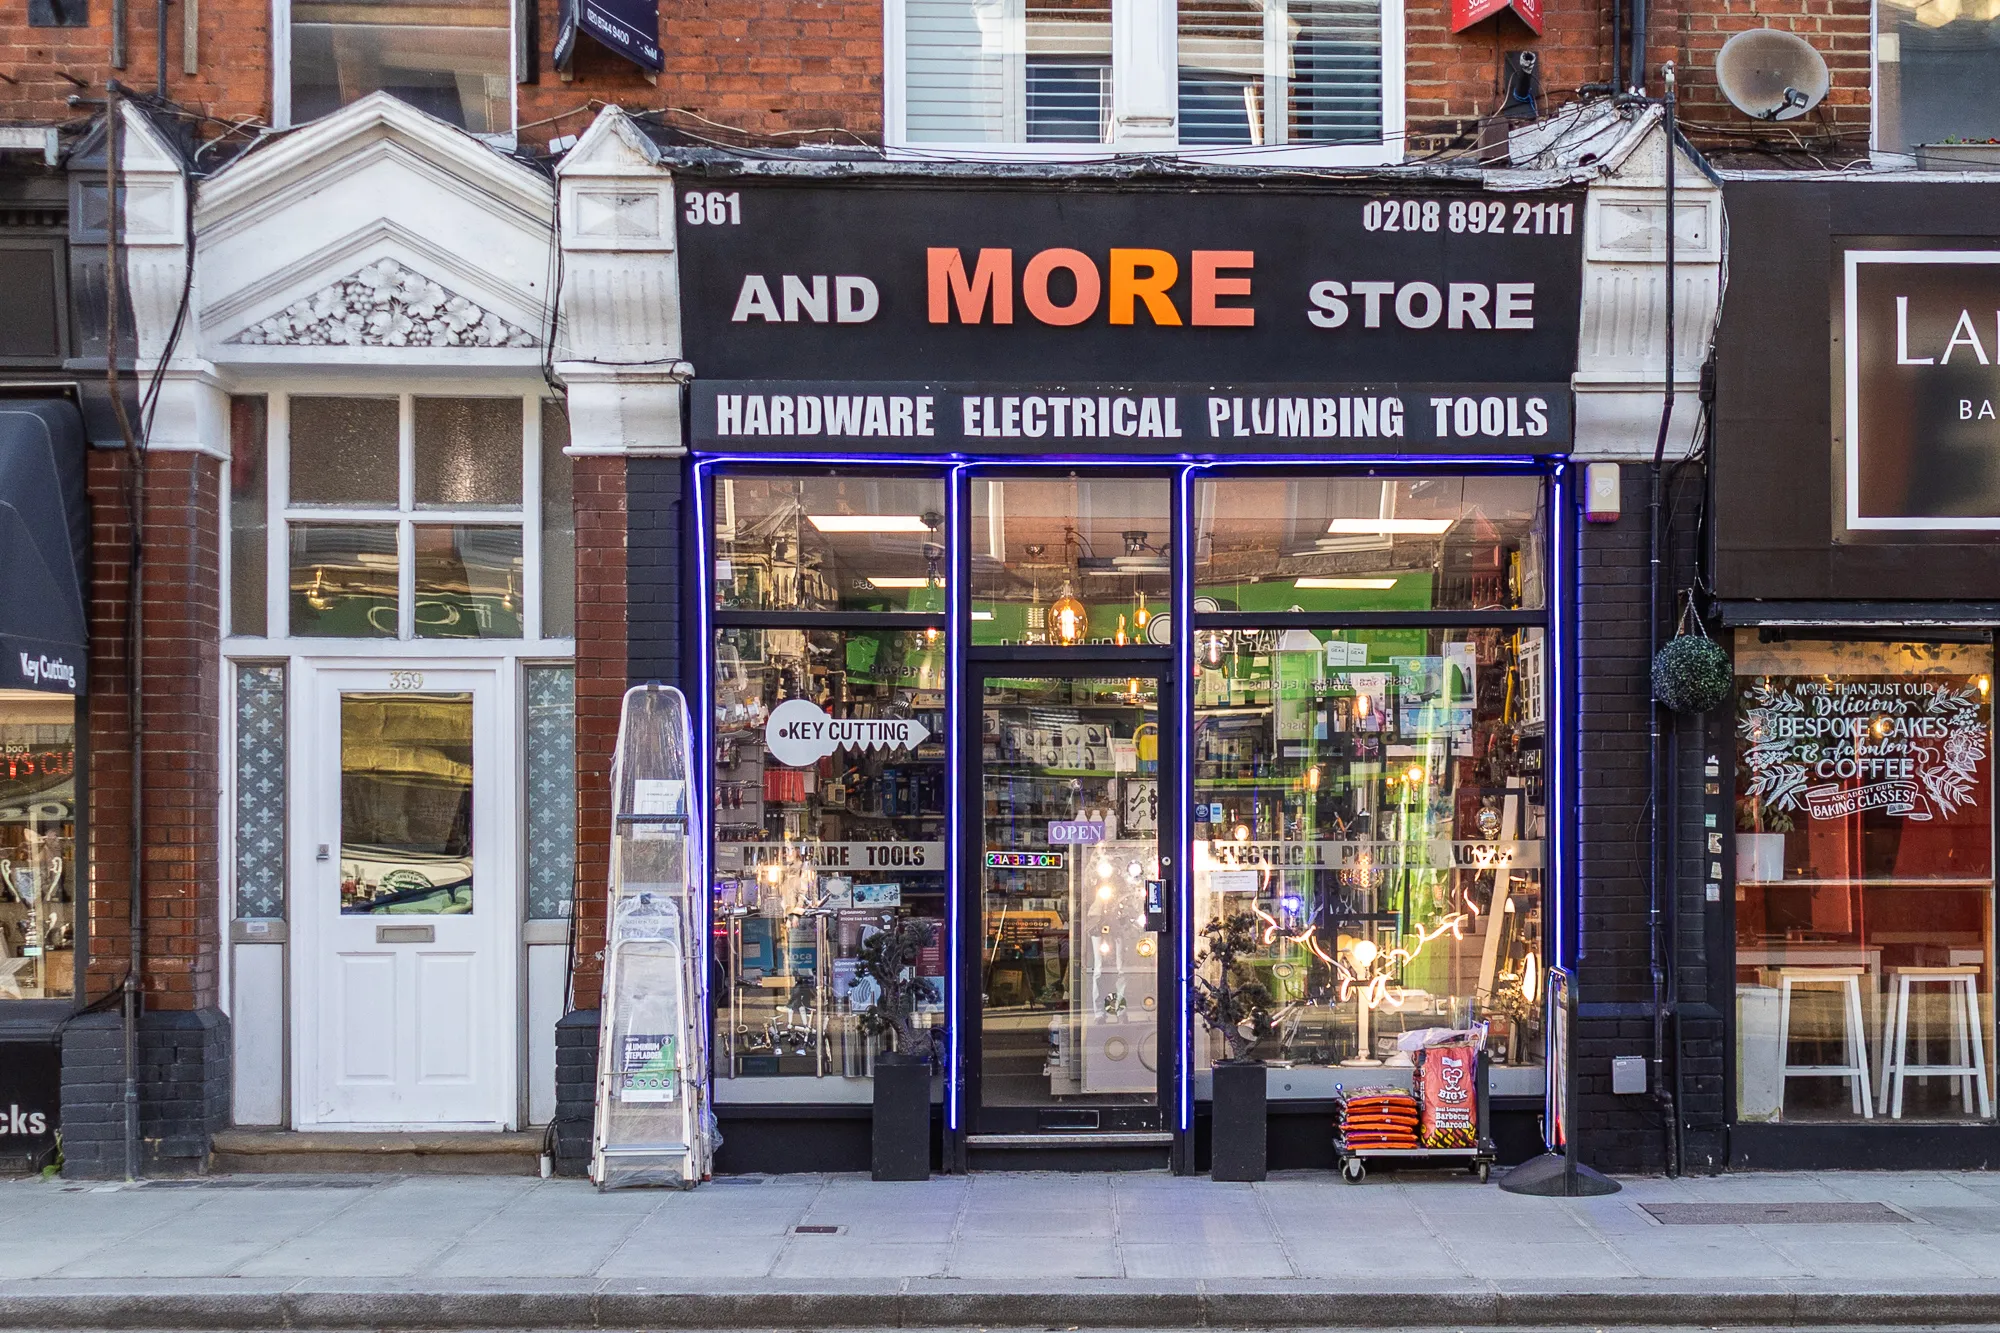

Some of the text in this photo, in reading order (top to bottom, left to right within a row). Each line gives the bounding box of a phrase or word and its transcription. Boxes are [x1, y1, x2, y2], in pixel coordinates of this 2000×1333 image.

[686, 192, 741, 225] 361
[1363, 200, 1574, 234] 0208 892 2111
[731, 247, 1535, 329] AND MORE STORE
[1896, 296, 2000, 365] LA
[716, 394, 1548, 438] HARDWARE ELECTRICAL PLUMBING TOOLS
[1959, 400, 1996, 420] BA
[20, 652, 77, 688] Key Cutting
[389, 670, 424, 690] 359
[1795, 682, 1936, 697] MORE THAN JUST OUR
[1813, 695, 1918, 716] Delicious
[788, 722, 909, 741] KEY CUTTING
[1778, 717, 1949, 739] BESPOKE CAKES
[1793, 737, 1930, 764] & fabulous
[0, 752, 36, 780] YS
[1815, 758, 1915, 780] COFFEE
[1830, 784, 1894, 801] ASK ABOUT OUR
[1813, 789, 1916, 818] BAKING CLASSES!
[1052, 825, 1103, 841] OPEN
[866, 845, 925, 866] TOOLS
[1219, 844, 1326, 866] ELECTRICAL
[624, 1051, 662, 1059] STEPLADDER
[625, 1042, 660, 1051] ALUMINIUM
[1438, 1089, 1467, 1099] BIG K
[0, 1104, 47, 1135] cks
[1436, 1112, 1469, 1120] Barbecue
[1436, 1120, 1470, 1128] Charcoal
